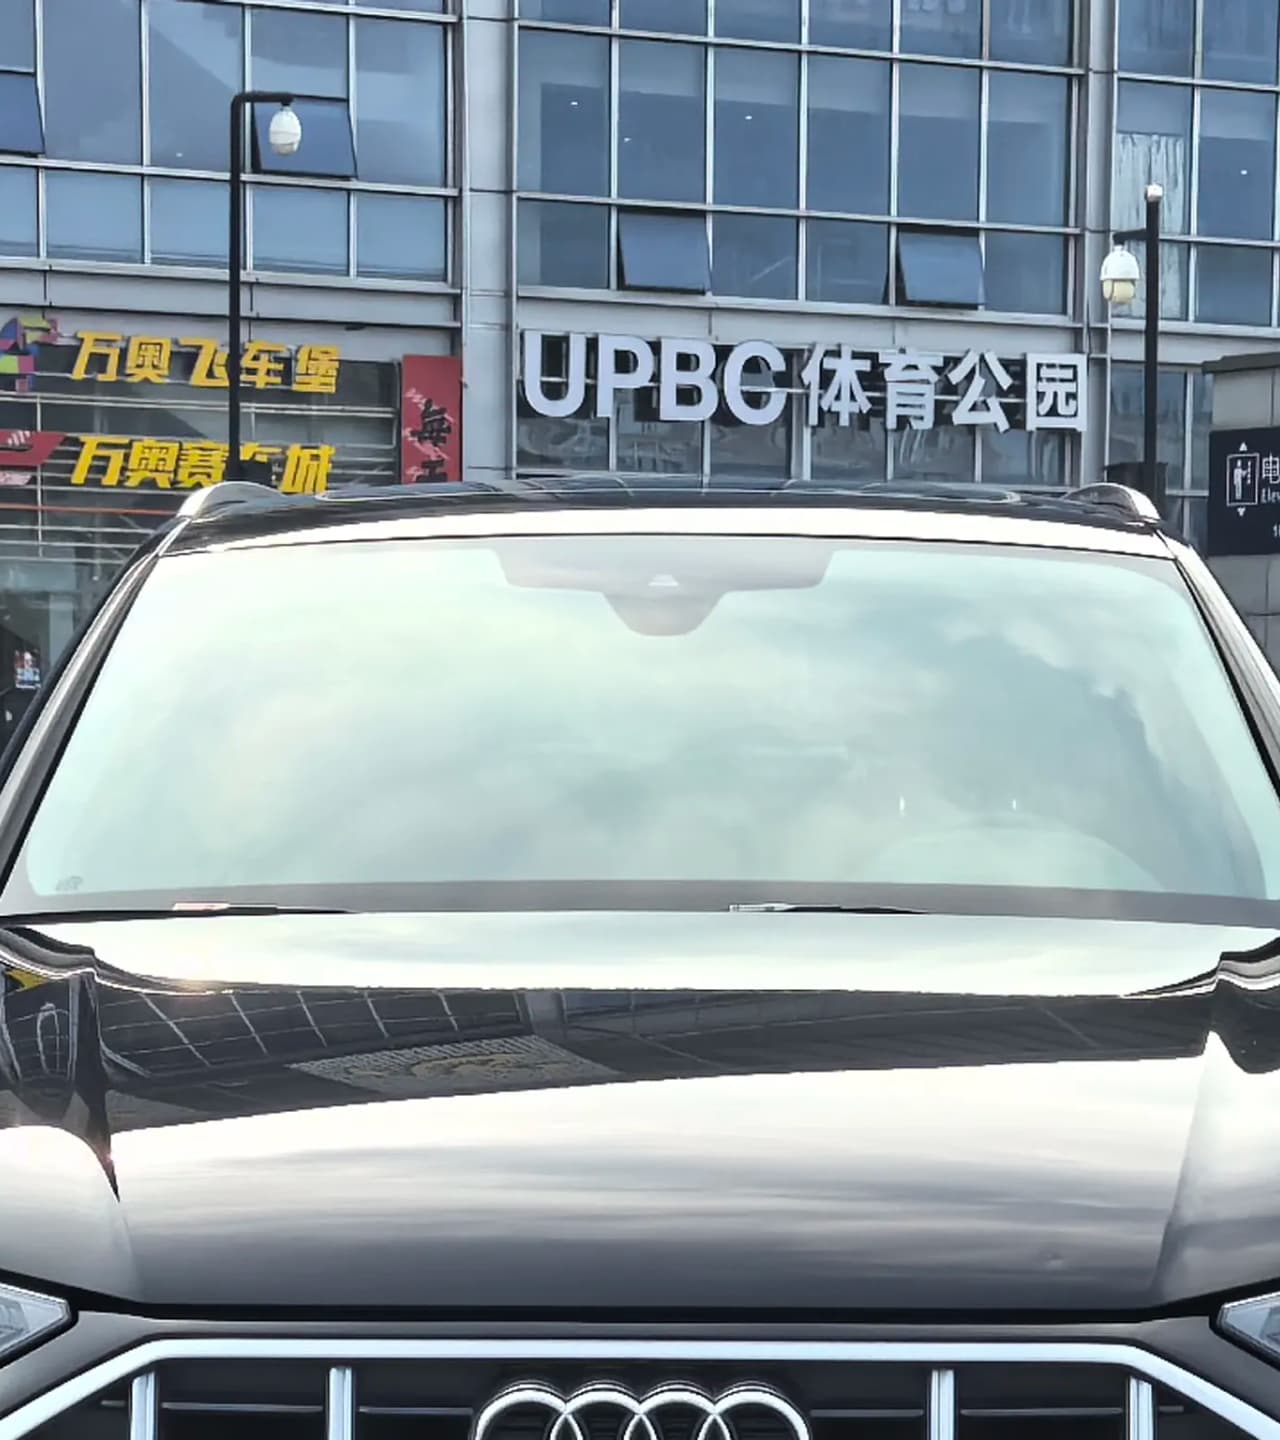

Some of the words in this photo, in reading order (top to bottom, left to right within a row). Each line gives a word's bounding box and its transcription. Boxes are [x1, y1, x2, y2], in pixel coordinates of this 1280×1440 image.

[71, 331, 341, 394] 万奥飞车堡
